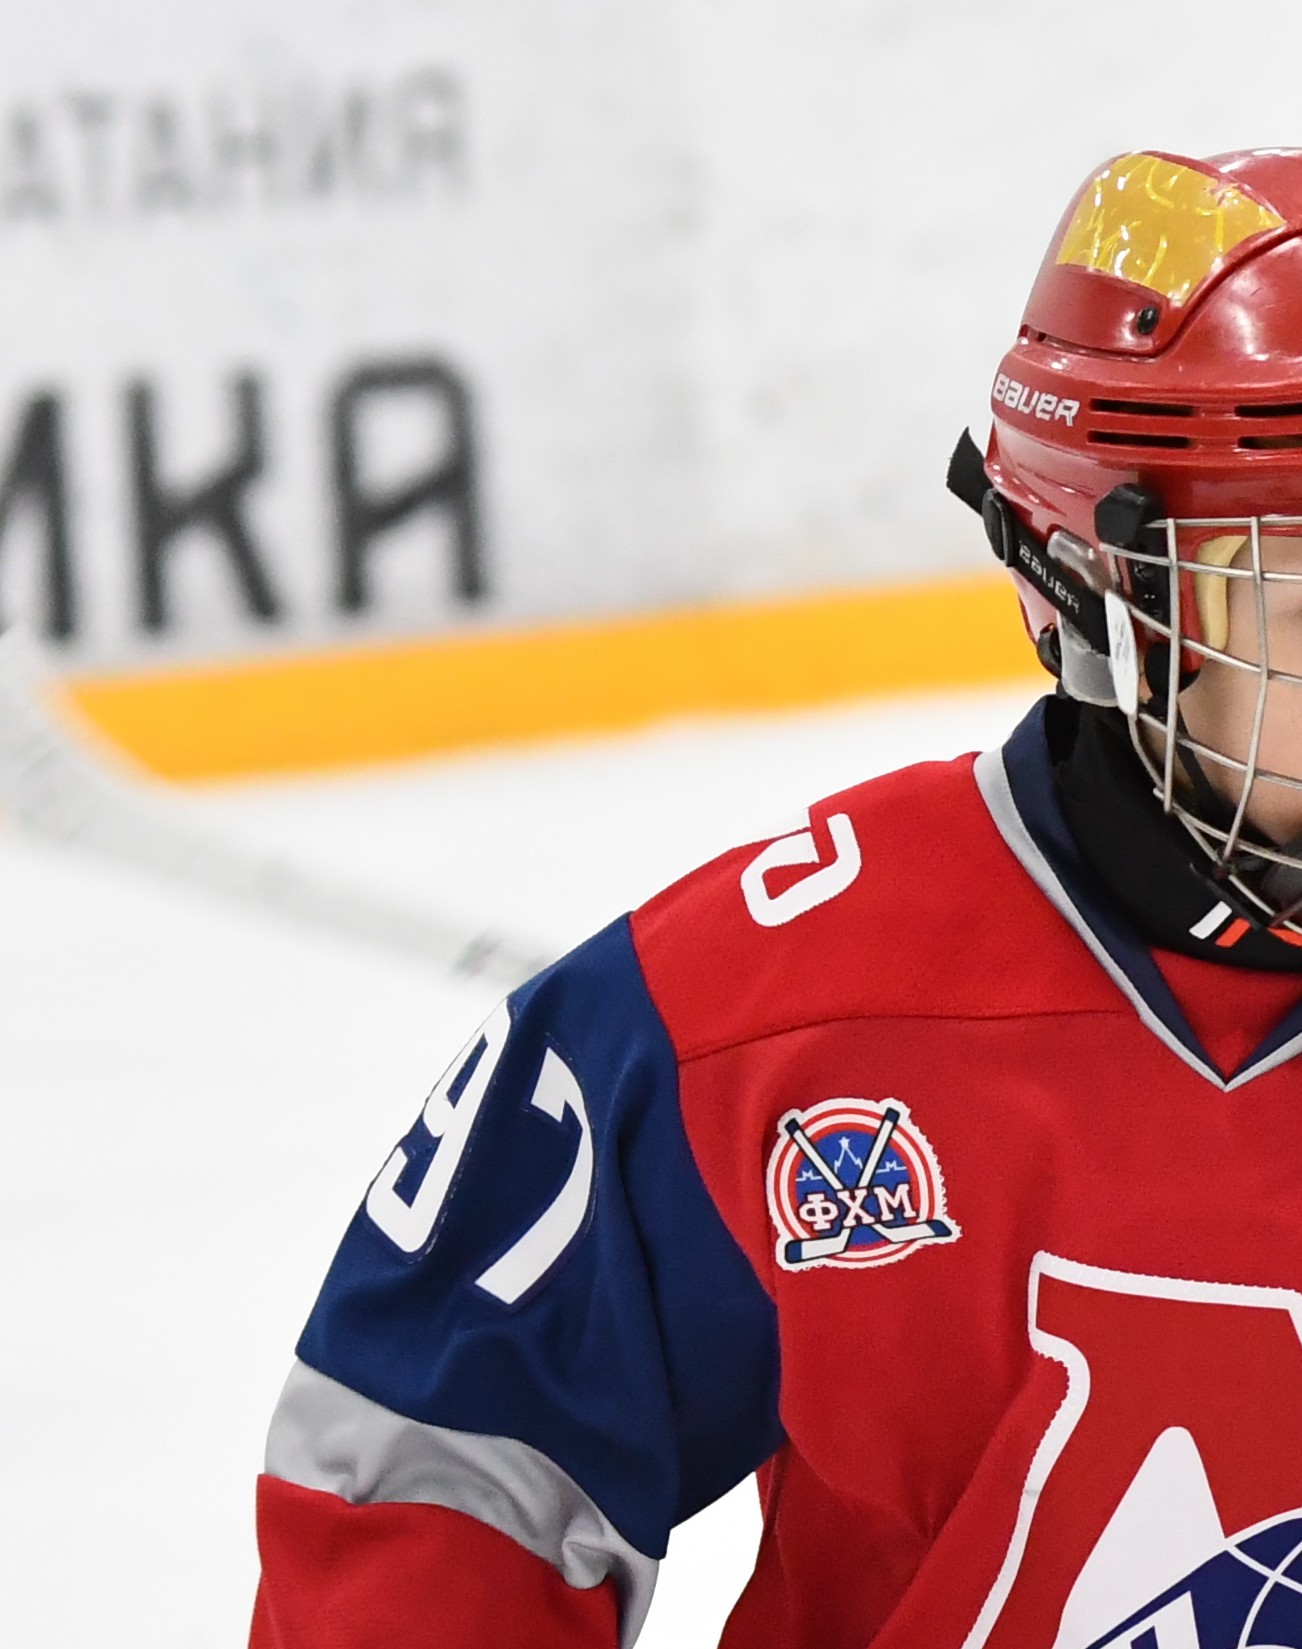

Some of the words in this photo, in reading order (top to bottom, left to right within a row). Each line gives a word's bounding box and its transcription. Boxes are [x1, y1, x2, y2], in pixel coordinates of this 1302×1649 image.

[993, 372, 1080, 427] BAUER
[363, 998, 596, 1305] 97
[798, 1183, 917, 1231] ФХМ
